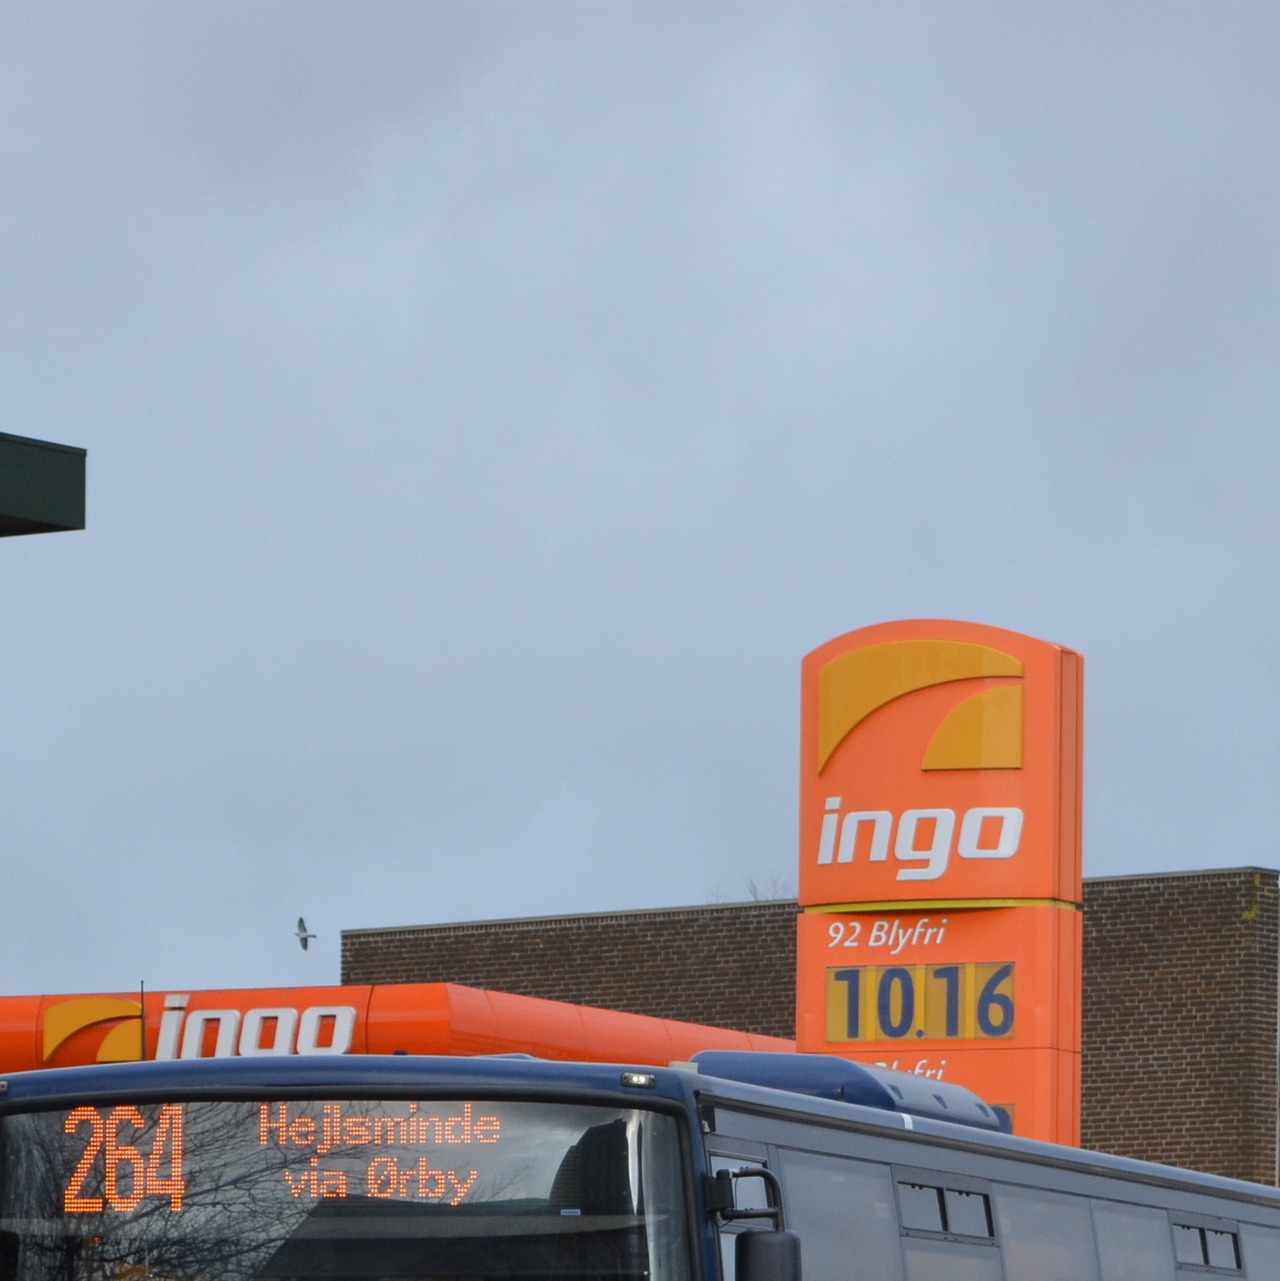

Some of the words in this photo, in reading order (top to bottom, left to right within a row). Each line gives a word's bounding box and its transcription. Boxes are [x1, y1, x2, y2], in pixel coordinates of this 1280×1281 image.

[816, 796, 1025, 882] ingo
[827, 921, 862, 948] 92
[868, 918, 949, 955] Blyfri
[155, 994, 357, 1061] ingo
[833, 963, 1015, 1040] 10.16
[63, 1105, 185, 1213] 264
[258, 1103, 502, 1154] Hejlsminde
[283, 1157, 348, 1199] via
[366, 1156, 478, 1207] Ørby
